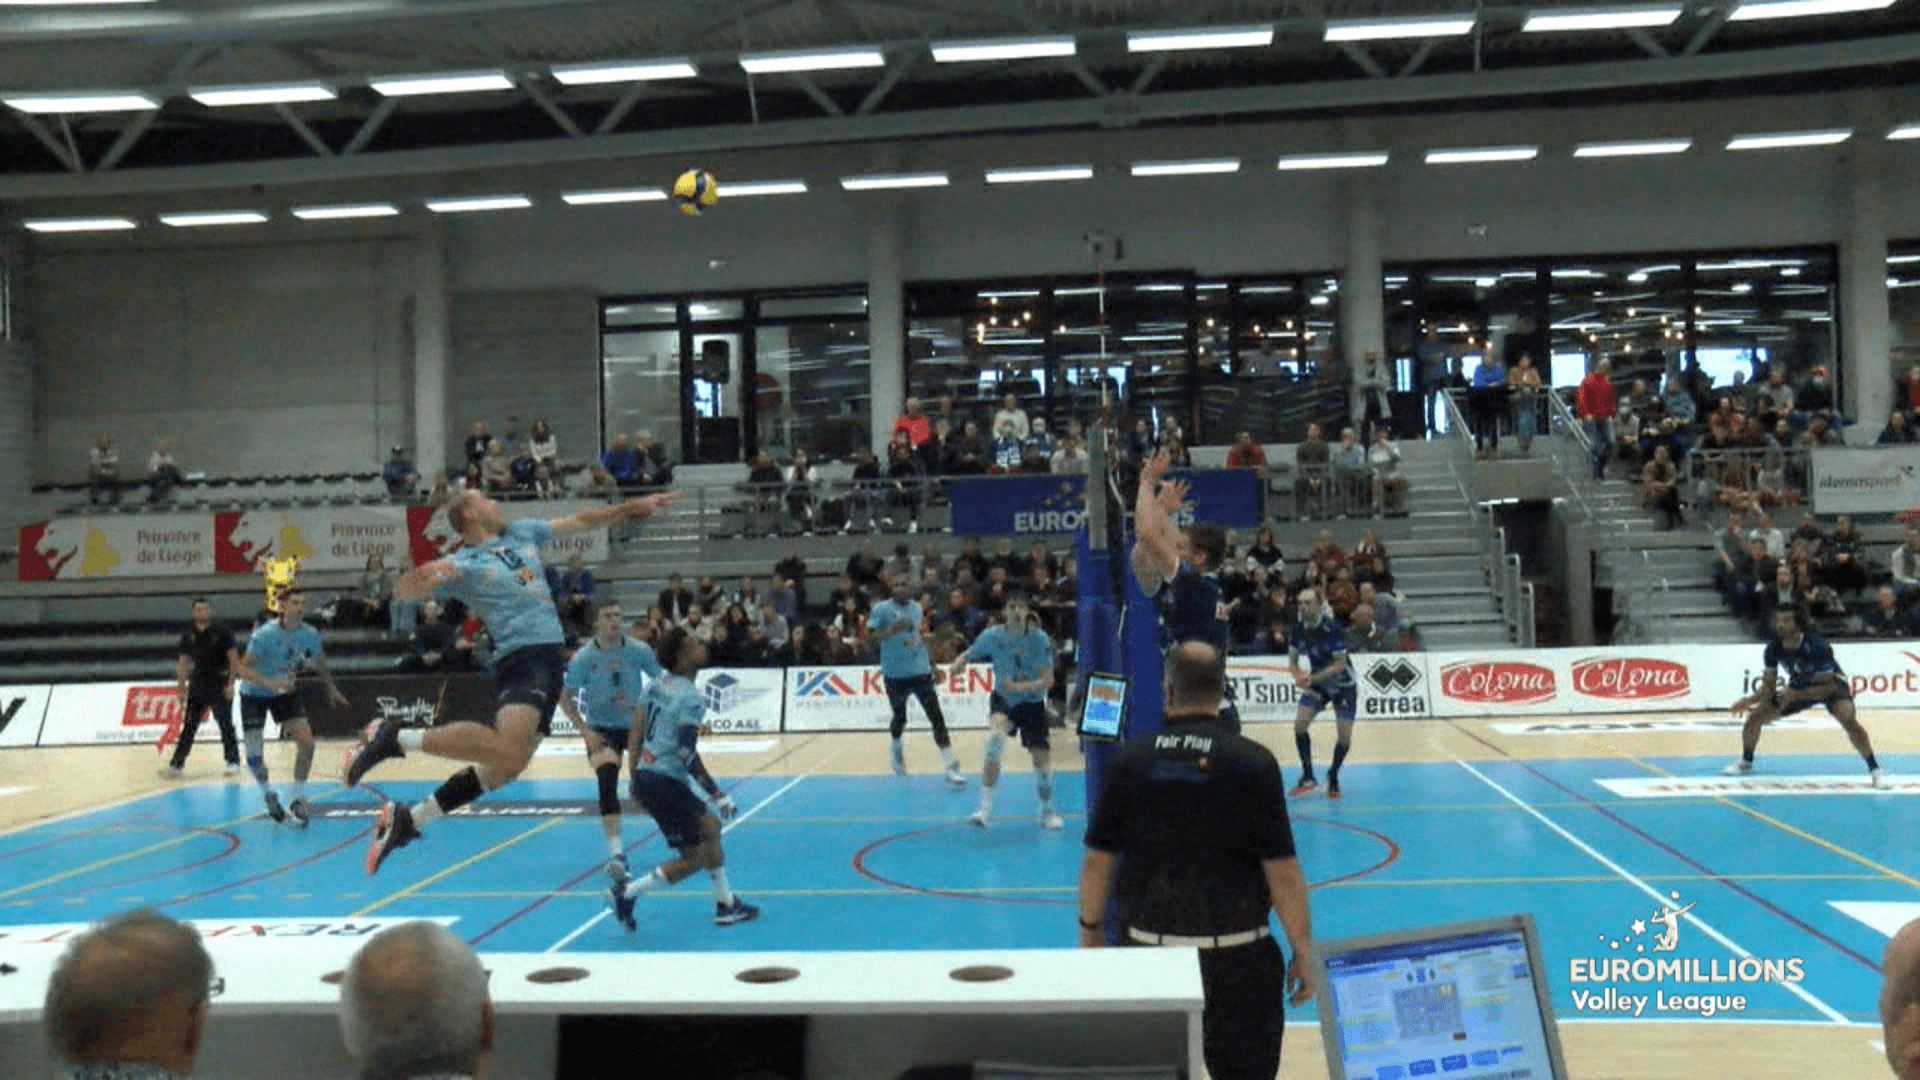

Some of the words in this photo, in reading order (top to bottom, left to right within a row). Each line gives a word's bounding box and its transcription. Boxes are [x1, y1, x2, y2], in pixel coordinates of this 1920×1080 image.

[331, 522, 395, 536] Province
[1449, 664, 1548, 696] Colona
[1579, 660, 1687, 692] Colona
[1155, 735, 1181, 749] Fair
[1183, 735, 1213, 753] Play
